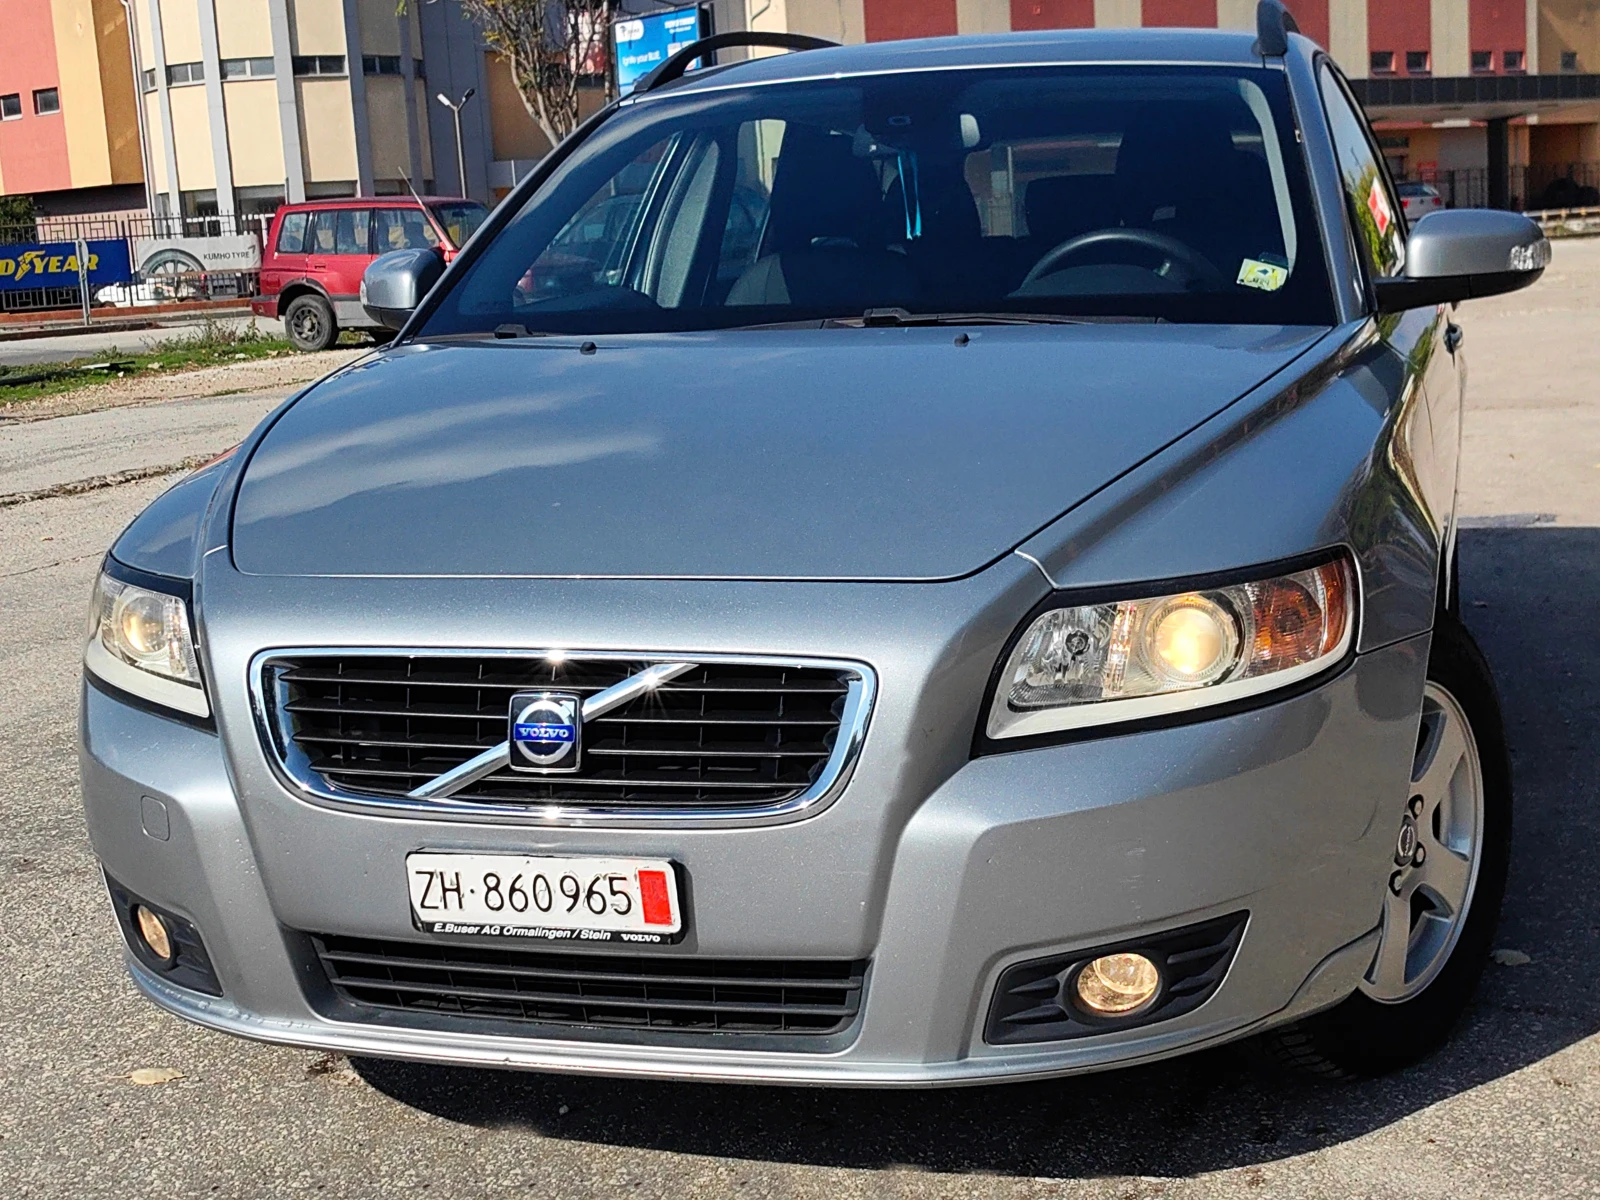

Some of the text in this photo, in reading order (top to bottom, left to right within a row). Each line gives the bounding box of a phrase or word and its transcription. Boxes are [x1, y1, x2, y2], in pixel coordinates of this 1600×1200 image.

[203, 251, 250, 261] KUMHO TYRE
[518, 727, 569, 738] VOLVO
[480, 925, 500, 935] AG
[503, 925, 571, 939] Ormalingen
[580, 929, 612, 940] Stein
[620, 933, 661, 943] VOLVO
